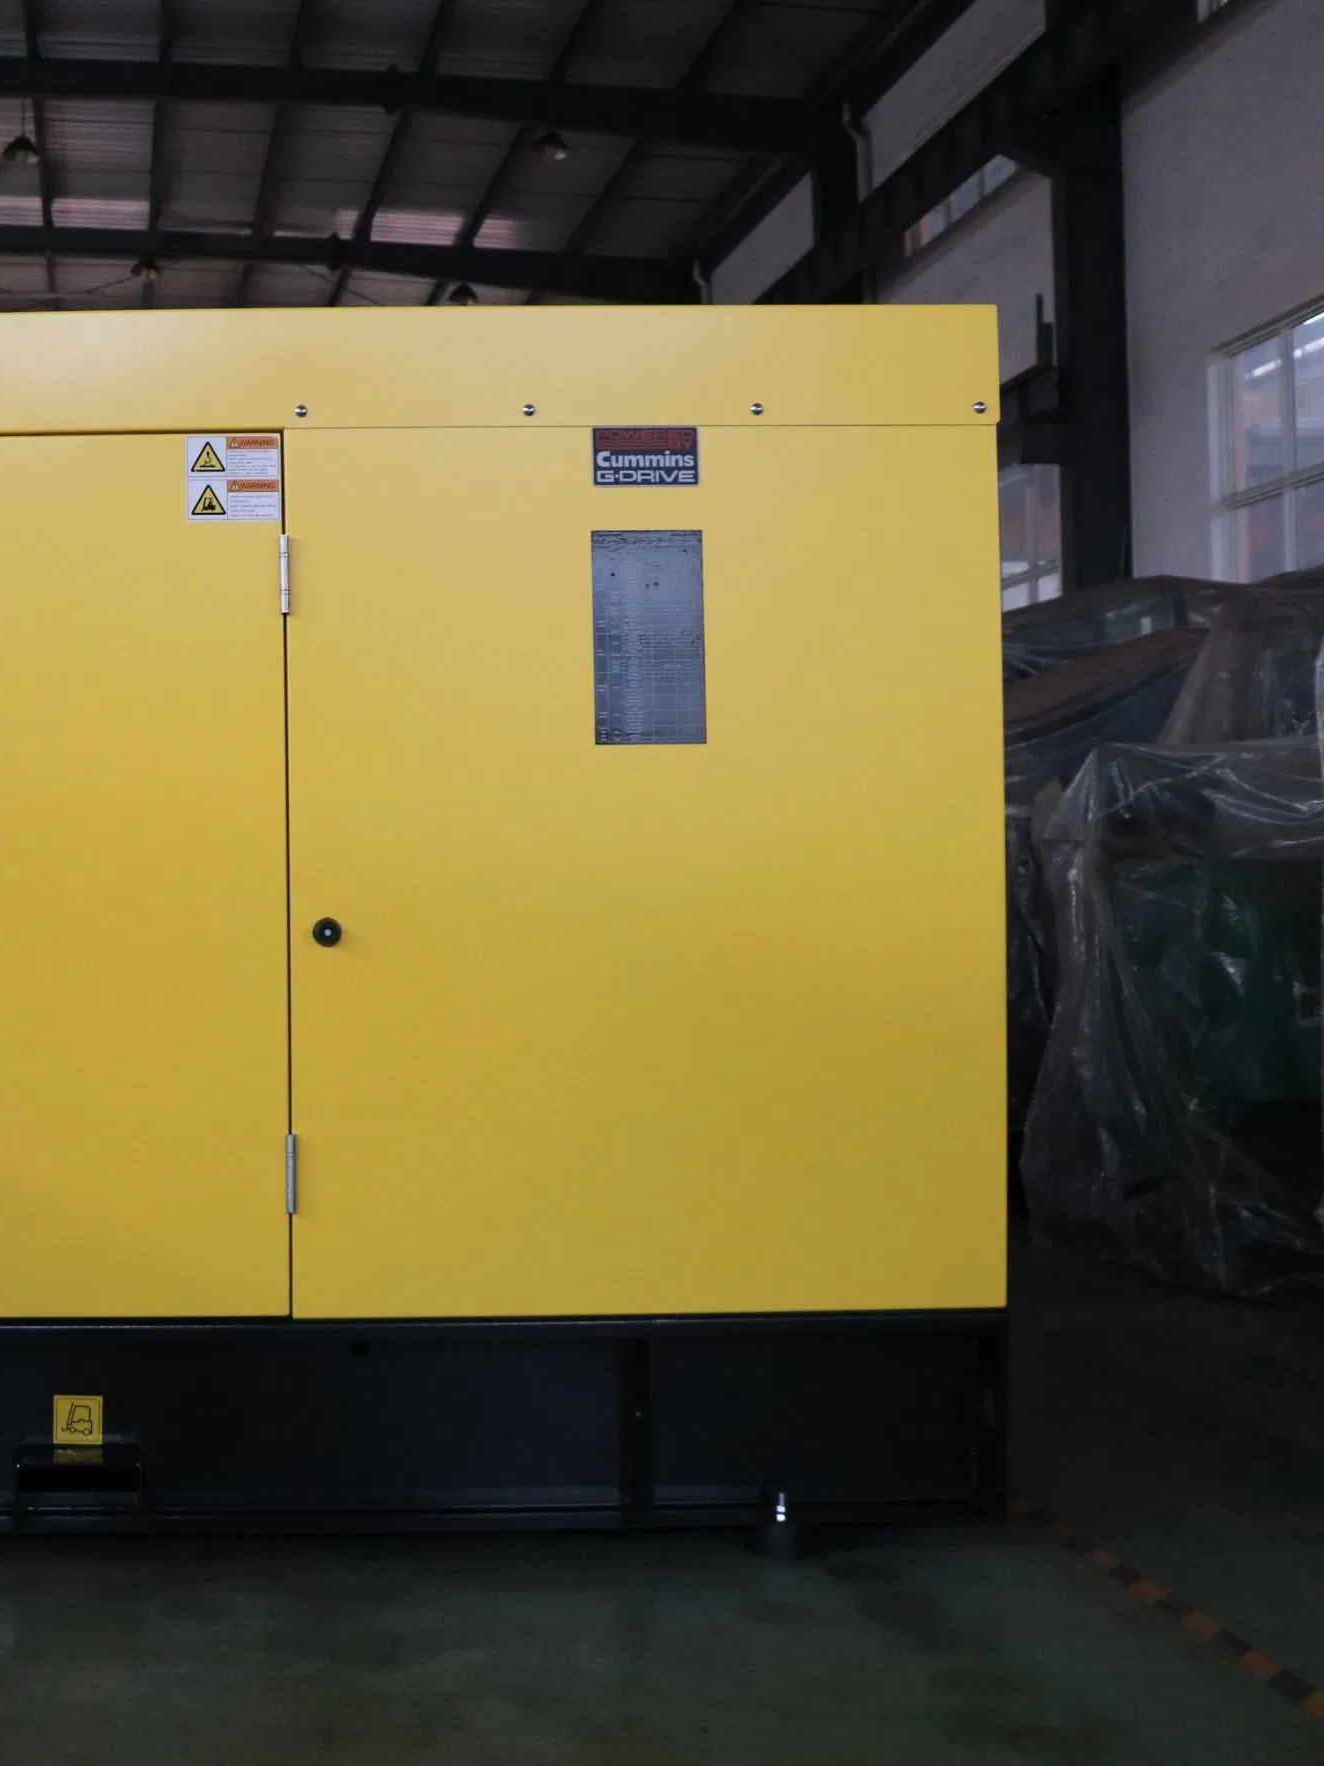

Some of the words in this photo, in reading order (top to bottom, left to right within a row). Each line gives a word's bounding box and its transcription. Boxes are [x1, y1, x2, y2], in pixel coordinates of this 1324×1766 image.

[596, 430, 694, 440] POWERED
[668, 440, 693, 449] BY
[596, 451, 695, 467] Cummins
